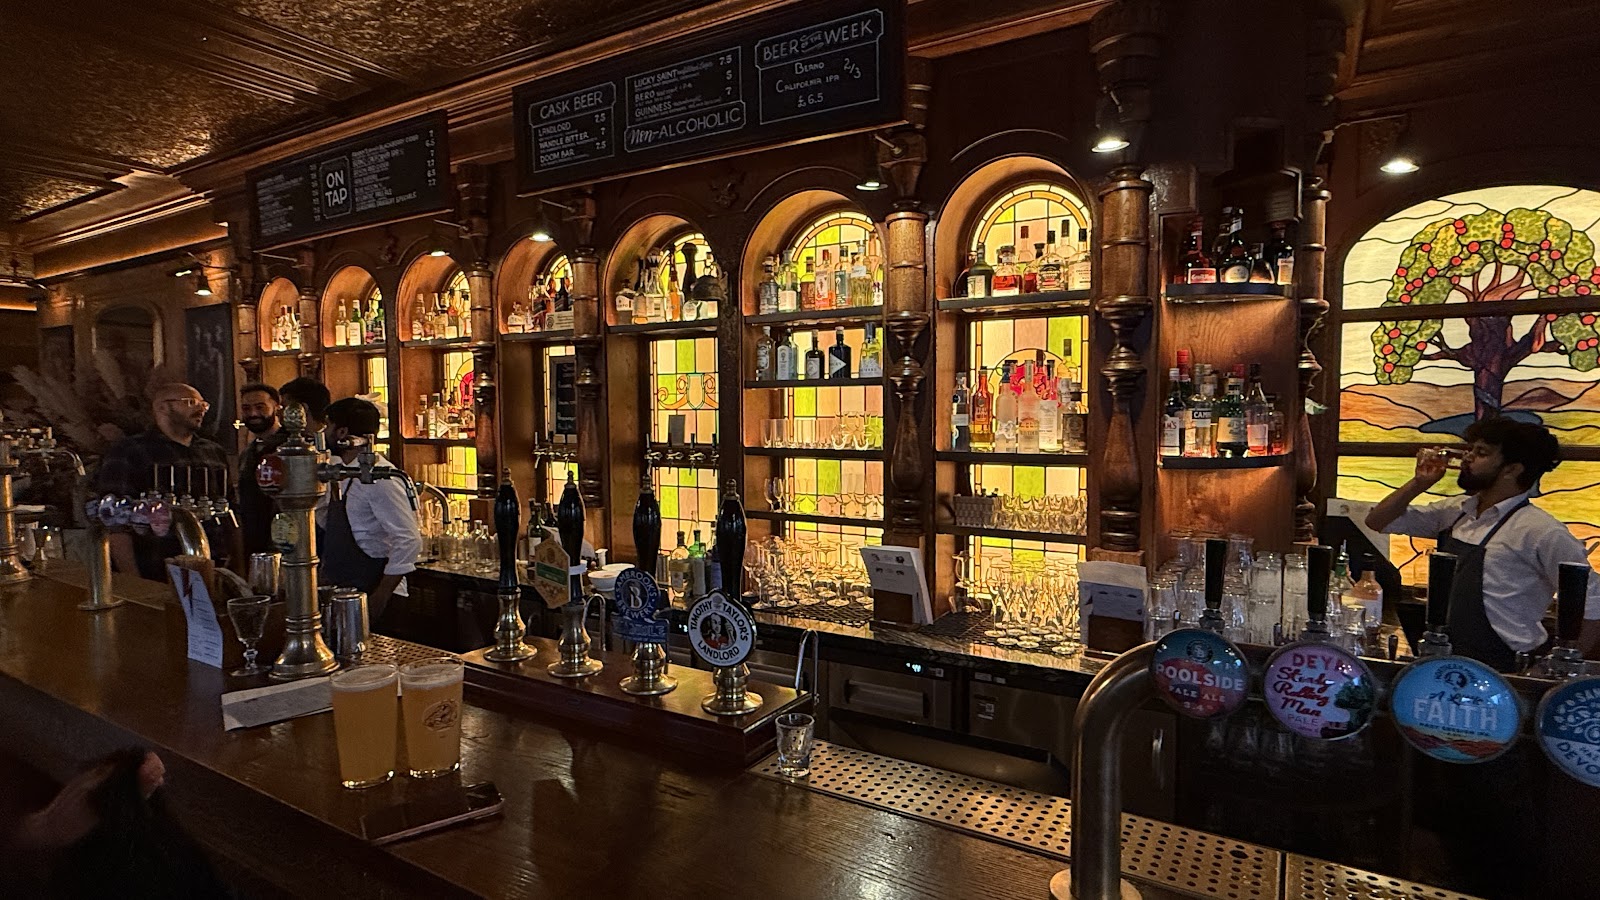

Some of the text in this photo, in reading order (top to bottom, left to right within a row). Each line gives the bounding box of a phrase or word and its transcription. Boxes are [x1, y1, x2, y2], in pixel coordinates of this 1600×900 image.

[763, 39, 800, 61] BEER
[823, 19, 873, 45] WEEK
[634, 76, 655, 88] LUCKY
[656, 69, 678, 81] SAINT
[825, 74, 840, 83] IPA
[540, 90, 603, 119] CASK BEER
[634, 89, 655, 103] BERO
[635, 101, 672, 117] GUINNESS
[725, 86, 732, 95] 7
[564, 131, 590, 144] BITTER
[540, 151, 560, 163] DOOM
[560, 148, 575, 158] BAR
[326, 169, 344, 189] ON
[325, 187, 348, 208] TAP
[615, 570, 658, 597] SAMBROOK'S
[691, 600, 713, 630] TIMOTHY
[722, 602, 750, 642] TAYLOR'S
[697, 640, 740, 660] LANDLORD
[1156, 663, 1245, 691] POOLSIDE
[1168, 685, 1226, 703] PALE ALE
[1280, 697, 1322, 717] Man
[1413, 697, 1498, 731] FAITH
[1287, 713, 1318, 727] PALE
